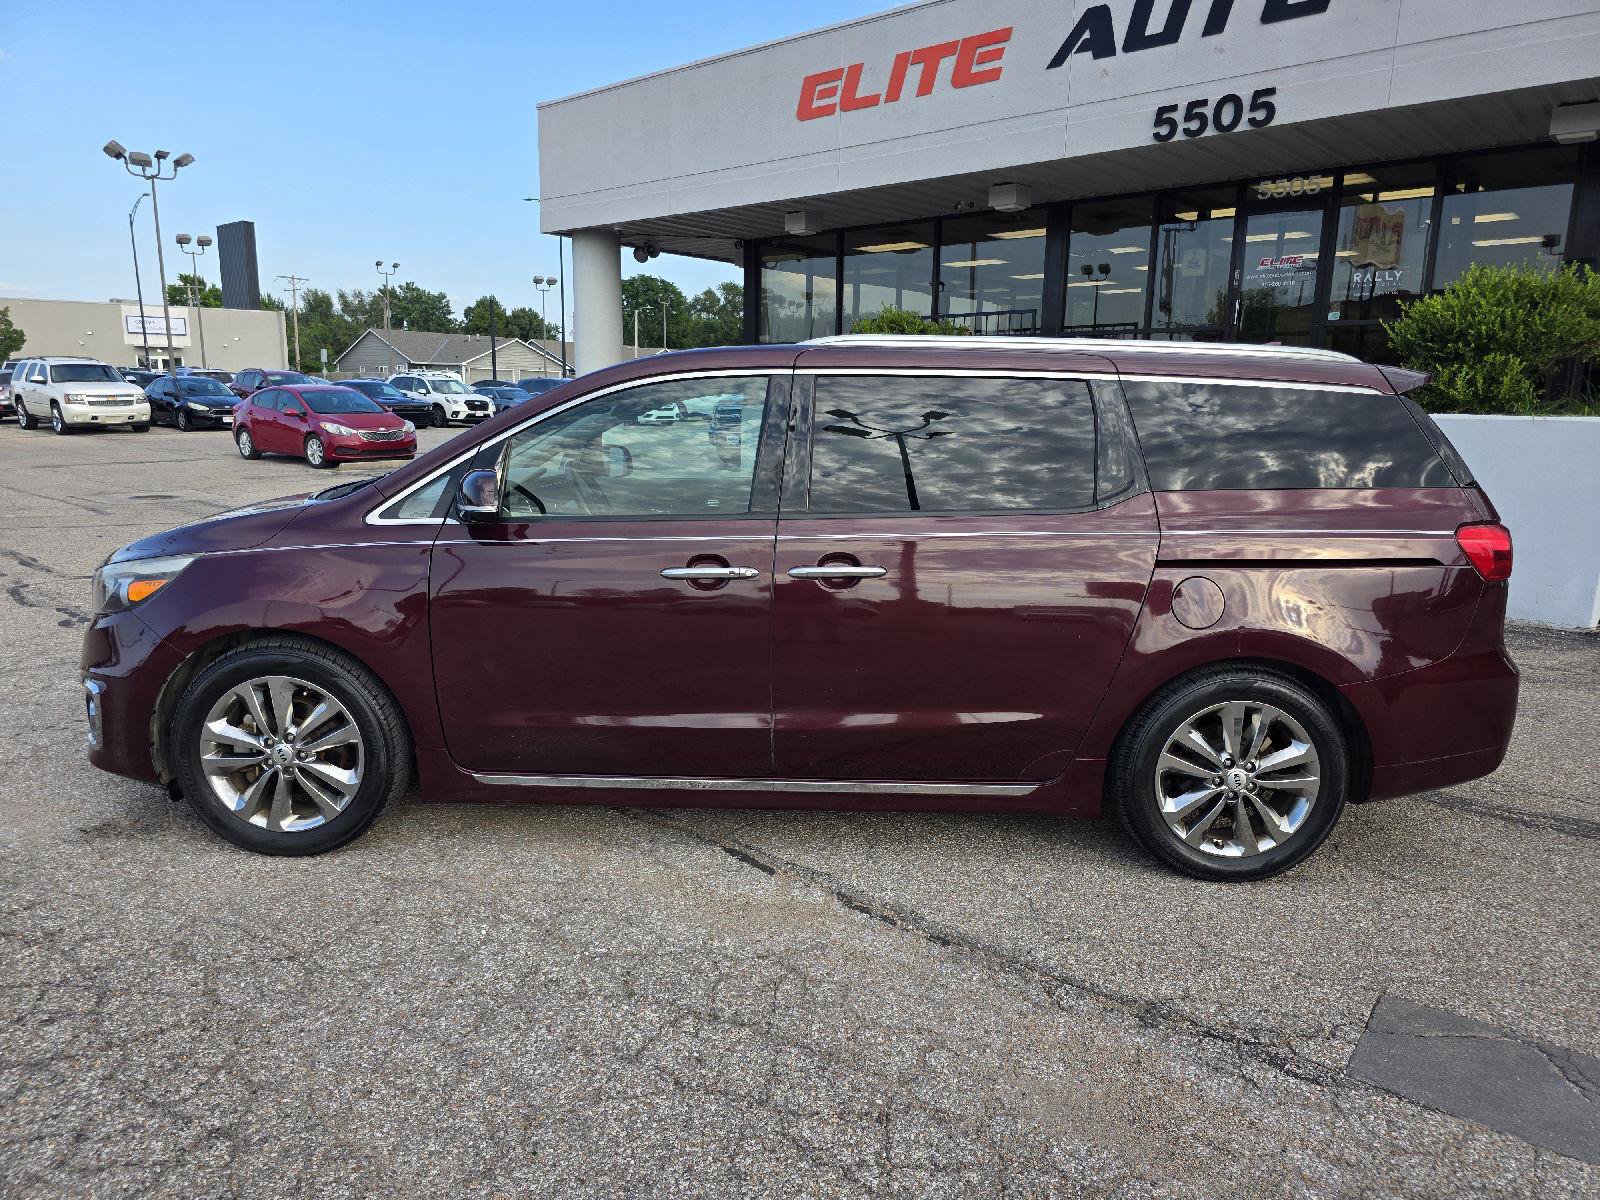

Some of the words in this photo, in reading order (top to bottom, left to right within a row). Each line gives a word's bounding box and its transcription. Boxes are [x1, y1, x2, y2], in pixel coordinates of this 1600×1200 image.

[797, 26, 1013, 121] ELITE
[1153, 87, 1276, 142] 5505
[1257, 175, 1322, 199] 5505
[1259, 256, 1304, 266] ELITE
[1353, 270, 1403, 282] RALLY
[276, 748, 287, 762] KIA
[1233, 773, 1241, 788] KIA
